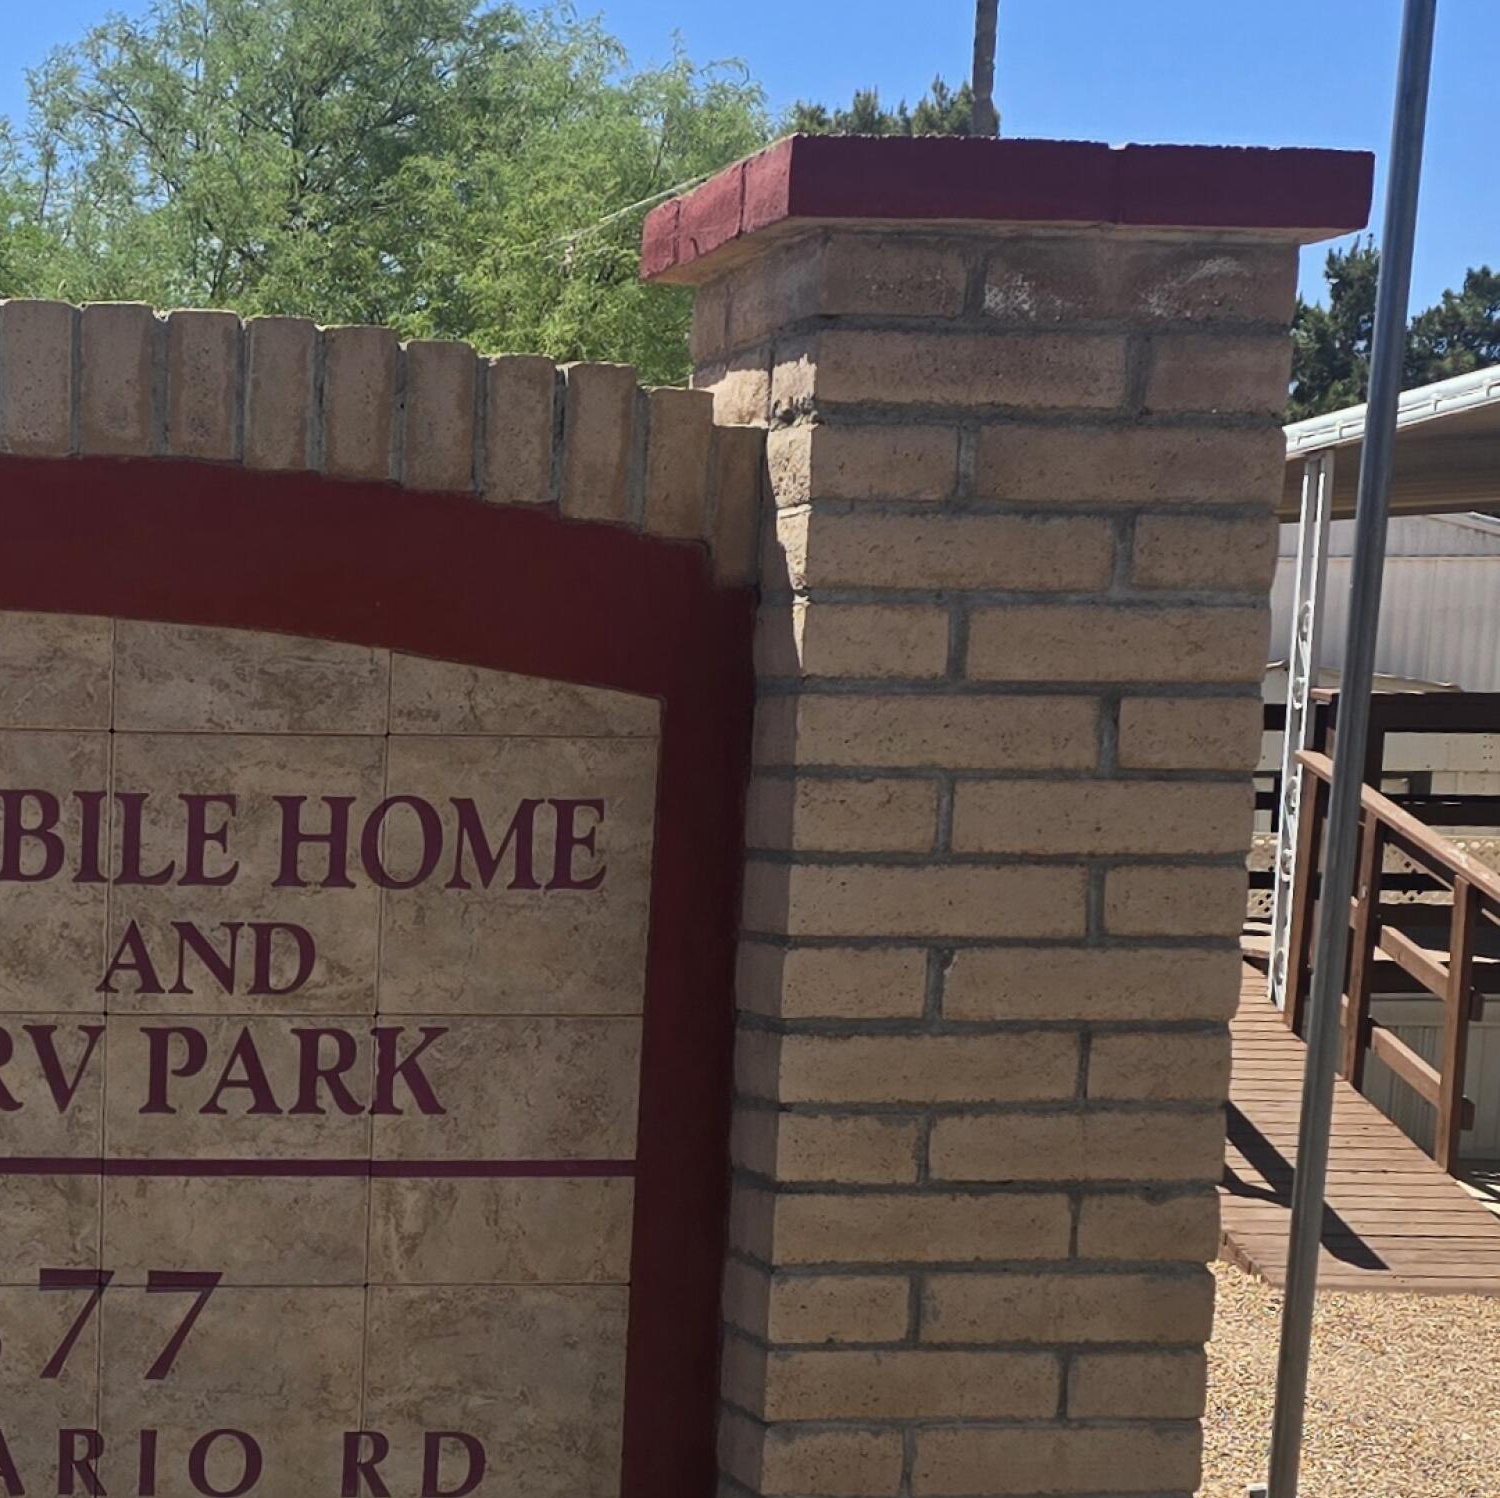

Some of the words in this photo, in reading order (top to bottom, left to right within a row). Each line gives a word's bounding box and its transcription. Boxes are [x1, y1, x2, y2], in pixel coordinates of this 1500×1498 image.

[269, 794, 607, 893] HOME
[95, 918, 317, 996] AND
[138, 1025, 450, 1117] PARK
